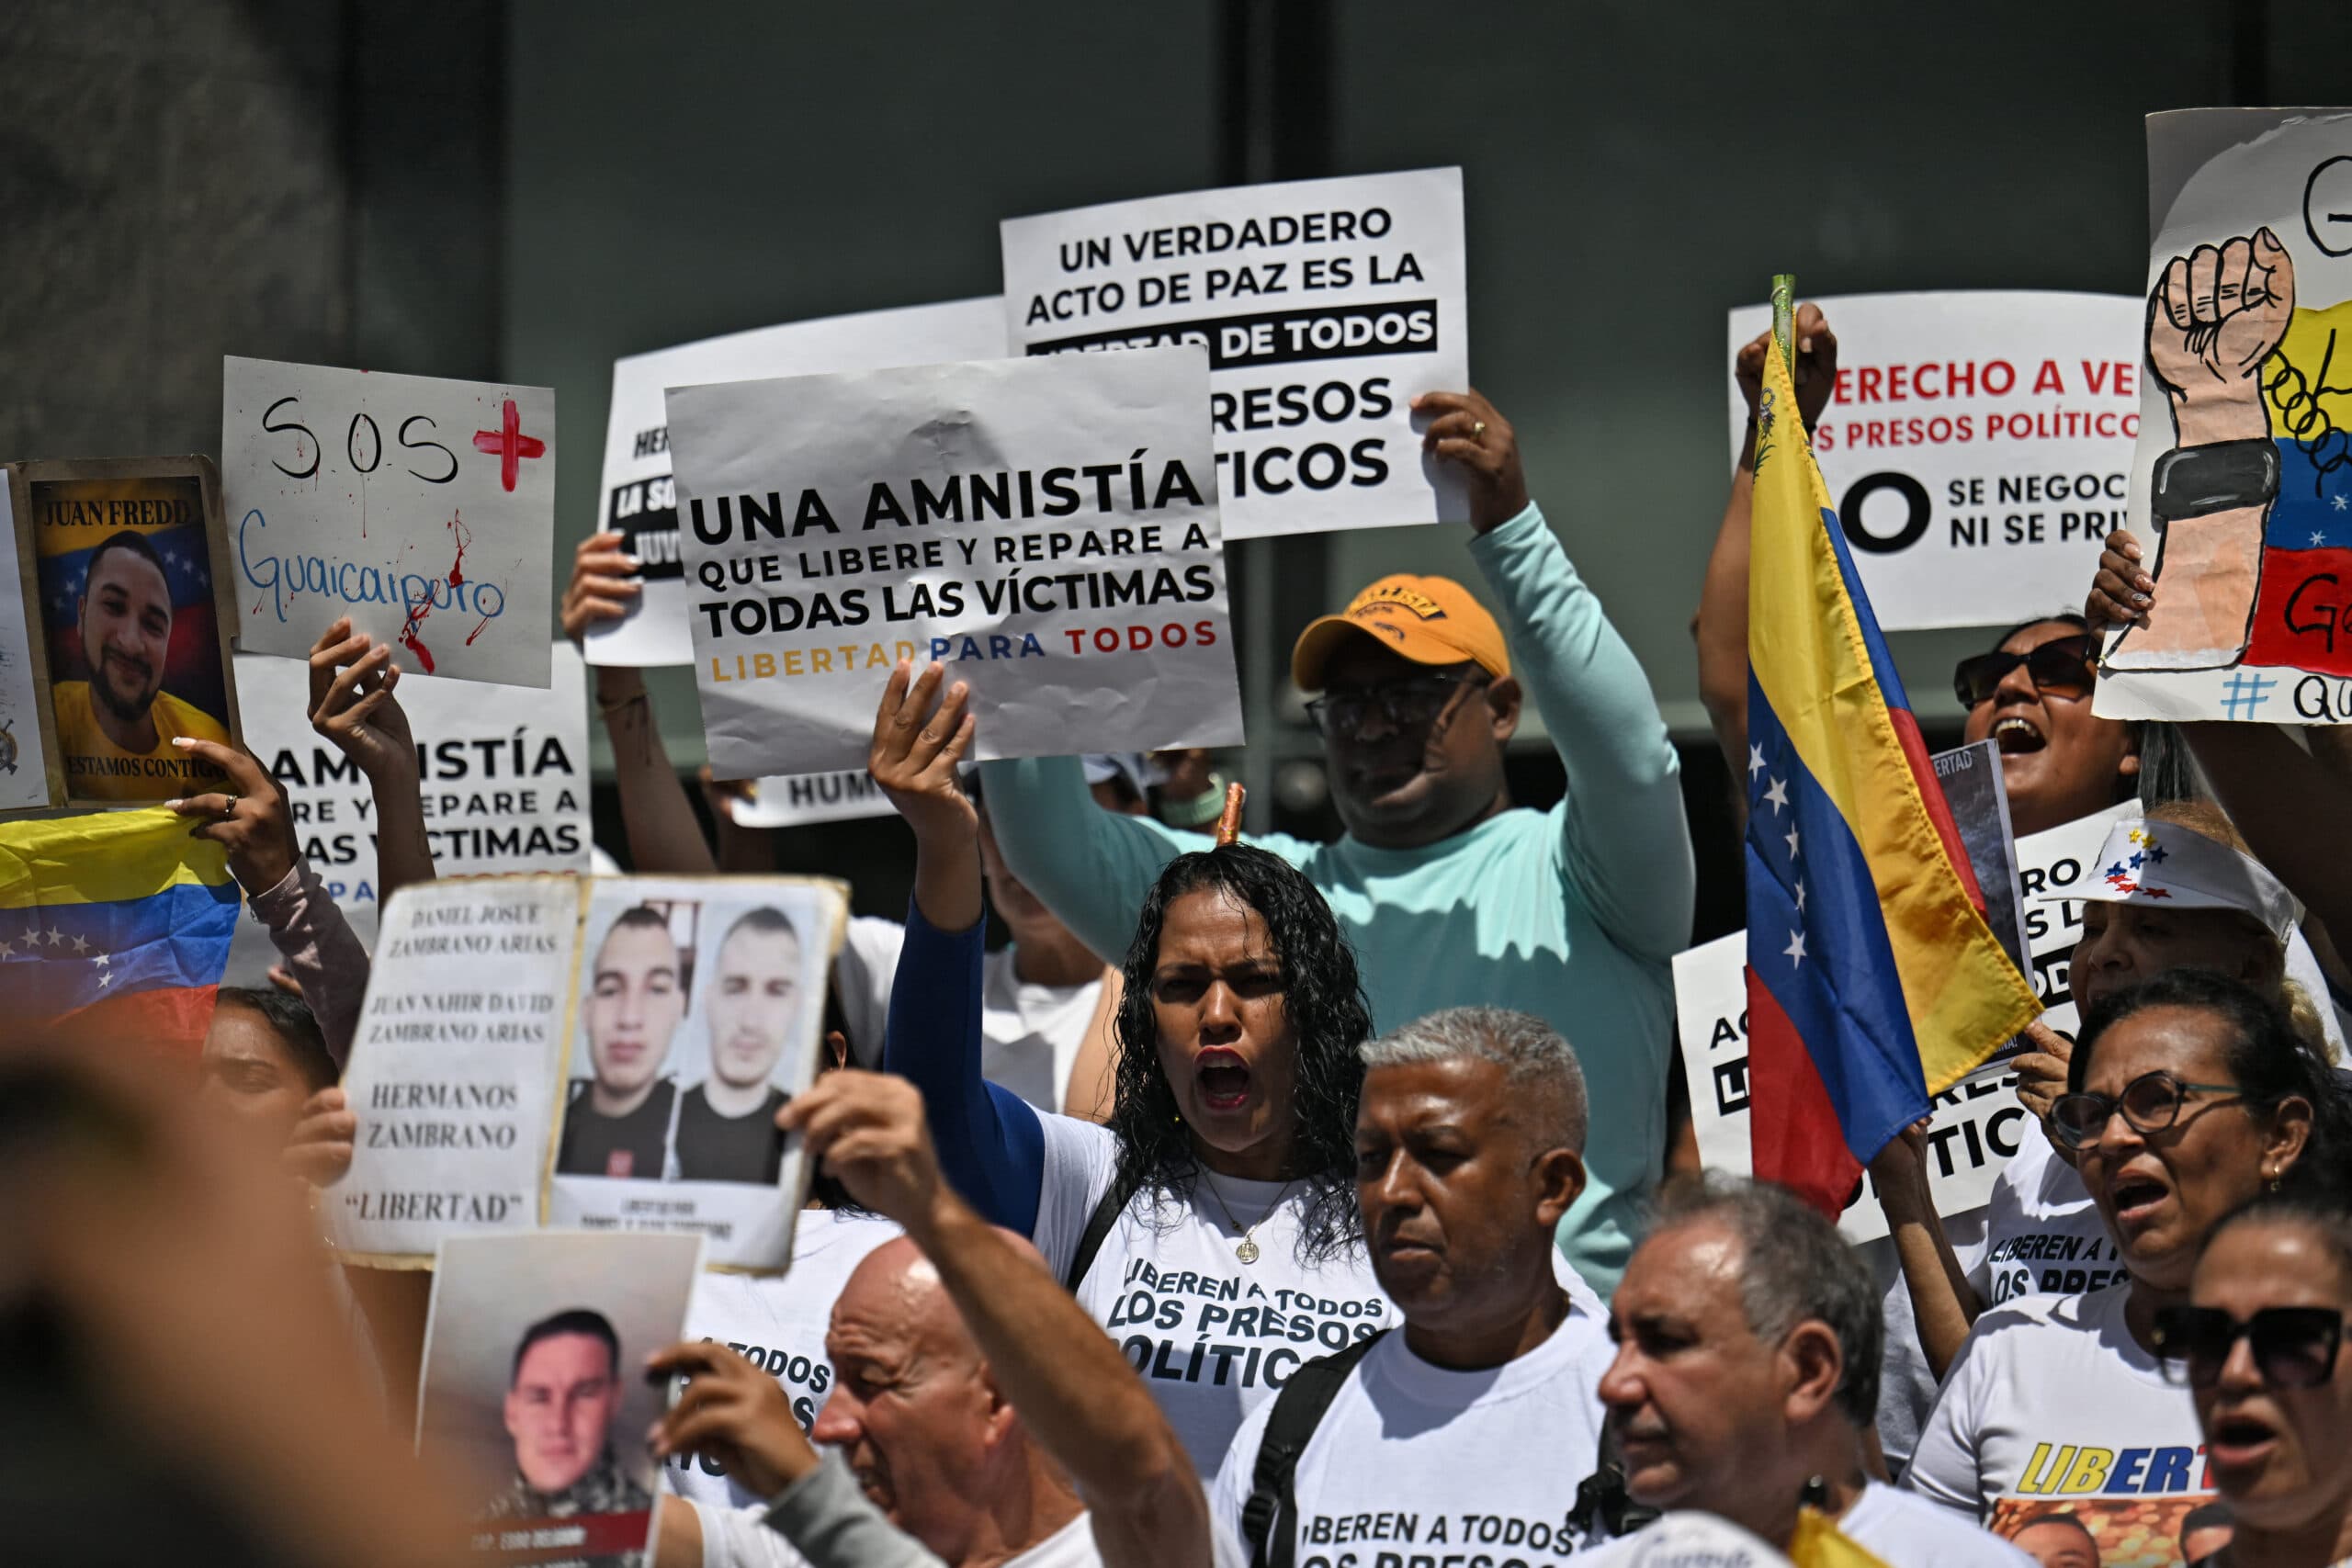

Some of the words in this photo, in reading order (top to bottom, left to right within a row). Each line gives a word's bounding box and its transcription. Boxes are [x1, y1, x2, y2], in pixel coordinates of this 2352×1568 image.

[1059, 236, 1111, 273] UN
[1124, 207, 1392, 262] VERDADERO
[1025, 283, 1125, 327] ACTO
[1139, 272, 1191, 310] DE
[1205, 263, 1287, 300] PAZ
[1304, 257, 1353, 290] ES
[1369, 253, 1425, 286] LA
[1220, 324, 1275, 358] DE
[1283, 310, 1433, 352] TODOS
[1835, 360, 2016, 404] ERECHO
[2032, 360, 2065, 395] A
[2081, 359, 2143, 397] VE
[1211, 378, 1393, 434] RESOS
[1847, 415, 1973, 449] PRESOS
[1987, 404, 2140, 440] POLÍTICO
[690, 488, 841, 546] UNA
[862, 448, 1204, 531] AMNISTÍA
[1949, 479, 1984, 506] SE
[1998, 473, 2127, 503] NEGOC
[45, 499, 103, 526] JUAN
[1951, 516, 1989, 547] NI
[2005, 514, 2044, 544] SE
[698, 555, 782, 592] QUE
[798, 540, 943, 580] LIBERE
[957, 537, 978, 566] Y
[996, 526, 1163, 564] REPARE
[1182, 523, 1210, 549] A
[699, 589, 870, 638] TODAS
[884, 581, 965, 623] LAS
[976, 564, 1216, 616] VÍCTIMAS
[712, 640, 917, 682] LIBERTAD
[930, 632, 1046, 661] PARA
[1065, 620, 1216, 655] TODOS
[67, 756, 141, 778] ESTAMOS
[270, 726, 574, 788] AMISTÍA
[1932, 750, 1973, 778] ERTAD
[352, 799, 372, 822] Y
[420, 791, 538, 818] EPARE
[555, 789, 578, 812] A
[305, 835, 357, 866] AS
[370, 824, 581, 861] CTIMAS
[389, 935, 492, 958] ZAMBRANO
[499, 935, 557, 954] ARIAS
[369, 1022, 479, 1043] ZAMBRANO
[485, 1023, 545, 1043] ARIAS
[371, 1082, 517, 1110] HERMANOS
[368, 1122, 516, 1149] ZAMBRANO
[1989, 1234, 2085, 1263] LIBEREN
[2081, 1237, 2103, 1261] A
[1125, 1258, 1240, 1302] LIBEREN
[1247, 1282, 1267, 1301] A
[1275, 1289, 1383, 1318] TODOS
[1107, 1291, 1185, 1330] LOS
[1427, 1516, 1449, 1544] A
[1462, 1515, 1575, 1556] TODOS
